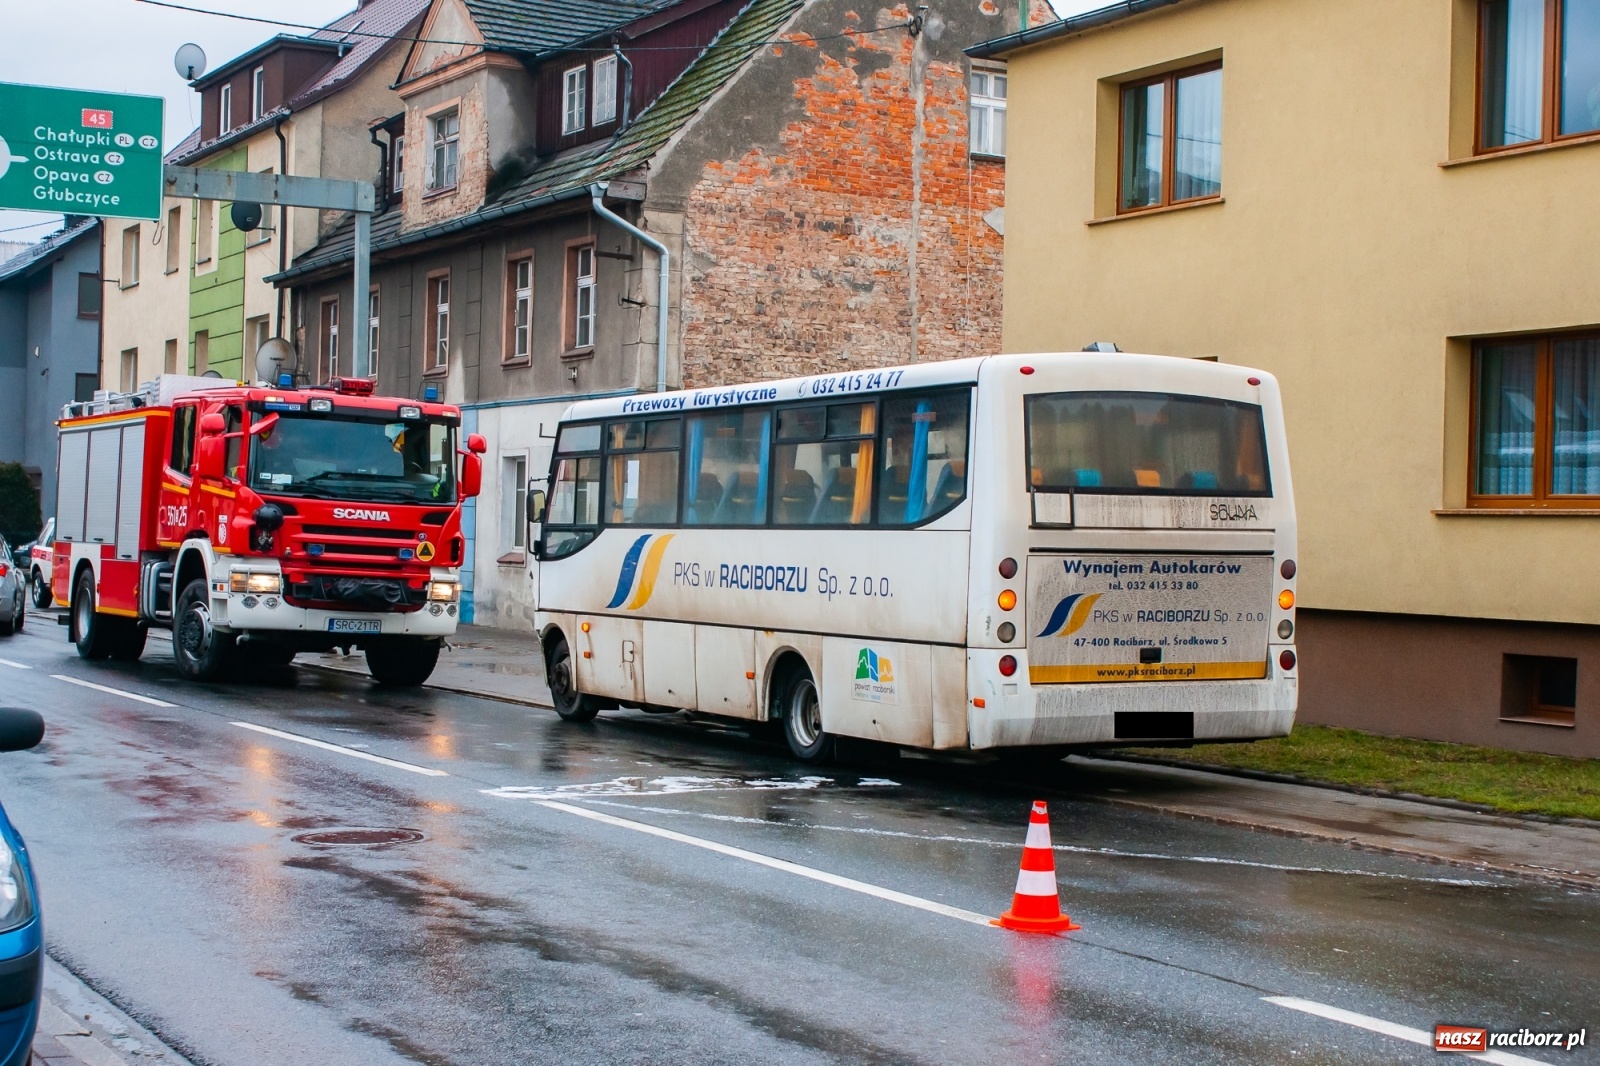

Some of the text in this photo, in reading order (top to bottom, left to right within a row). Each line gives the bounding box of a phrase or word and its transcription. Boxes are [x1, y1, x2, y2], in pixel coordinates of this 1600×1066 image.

[89, 113, 106, 125] 45
[34, 126, 155, 148] Chałupki PL CZ
[34, 146, 121, 164] Ostrava CZ
[34, 165, 110, 184] Opava CZ
[33, 185, 120, 207] Głubczyce
[812, 370, 904, 395] 032 415 24 77
[622, 387, 777, 413] Przewozy Turystyczne
[333, 508, 390, 521] SCANIA
[1063, 560, 1242, 577] Wynajem Autokarów
[674, 562, 894, 601] PKS w RACIBORZU Sp. z o.o.
[1109, 581, 1199, 590] tel. 032 415 33 80
[1093, 610, 1119, 622] PKS
[1137, 610, 1210, 622] RACIBORZU
[1214, 610, 1232, 625] Sp.
[1237, 613, 1242, 621] z
[1246, 612, 1266, 622] o.o.
[1073, 637, 1110, 647] 47-400
[1159, 636, 1170, 645] ul.
[1174, 634, 1219, 645] Środkowa
[1222, 636, 1228, 645] 5
[1097, 665, 1196, 678] www.pksraciborz.pl
